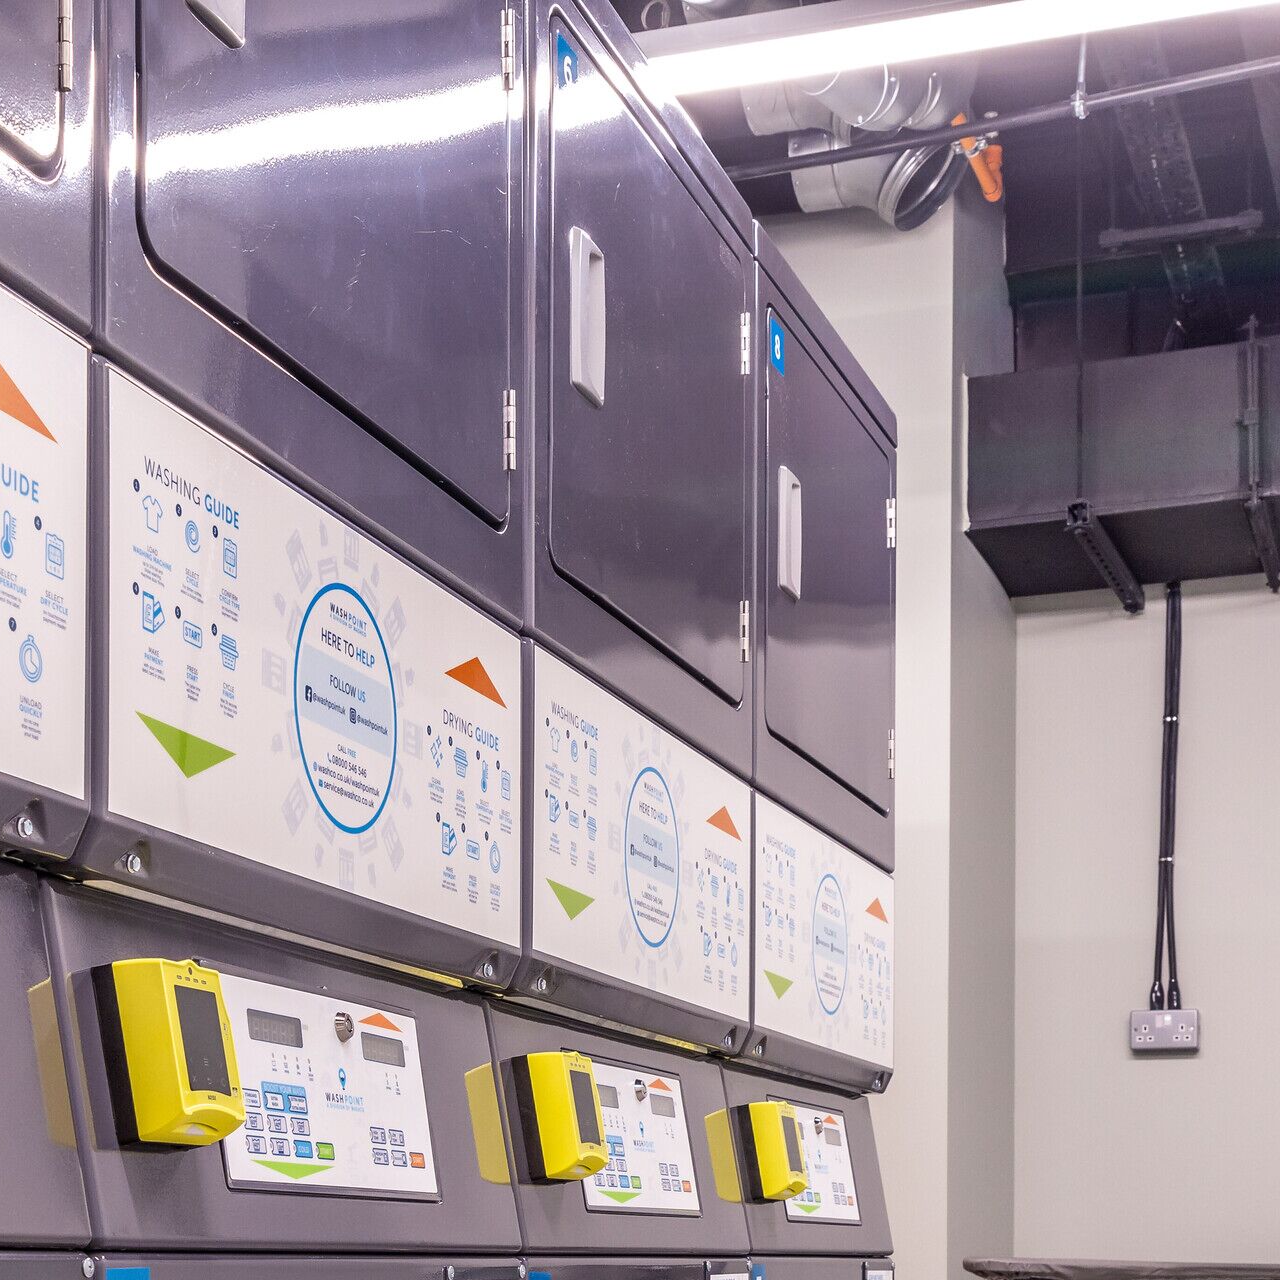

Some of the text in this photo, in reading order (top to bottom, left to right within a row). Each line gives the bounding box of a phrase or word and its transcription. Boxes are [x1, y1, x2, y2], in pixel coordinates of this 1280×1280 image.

[563, 55, 573, 85] 6
[774, 334, 781, 360] 8
[143, 455, 240, 530] WASHING GUIDE
[147, 545, 159, 556] LOAD
[185, 568, 200, 579] SELECT
[40, 596, 69, 616] DRY CYCLE
[45, 590, 64, 604] SELECT
[330, 602, 367, 631] WASHPOINT
[184, 626, 201, 642] START
[321, 627, 375, 669] HERE TO HELP
[329, 674, 367, 703] FOLLOW US
[19, 695, 42, 710] UNLOAD
[19, 704, 42, 718] QUICKLY
[313, 693, 346, 715] @washpointuk
[356, 714, 388, 736] @washpointuk
[442, 709, 499, 752] DRYING GUIDE
[551, 700, 598, 741] WASHING GUIDE
[337, 743, 357, 759] CALL FREE
[332, 755, 367, 778] 08000 546 546
[318, 763, 380, 797] washco.co.uk/washpointuk
[323, 780, 374, 808] service@washco.co.uk
[638, 801, 668, 825] HERE TO HELP
[642, 833, 658, 847] FOLLOW
[704, 847, 737, 875] DRYING GUIDE
[325, 1092, 363, 1106] WASHPOINT
